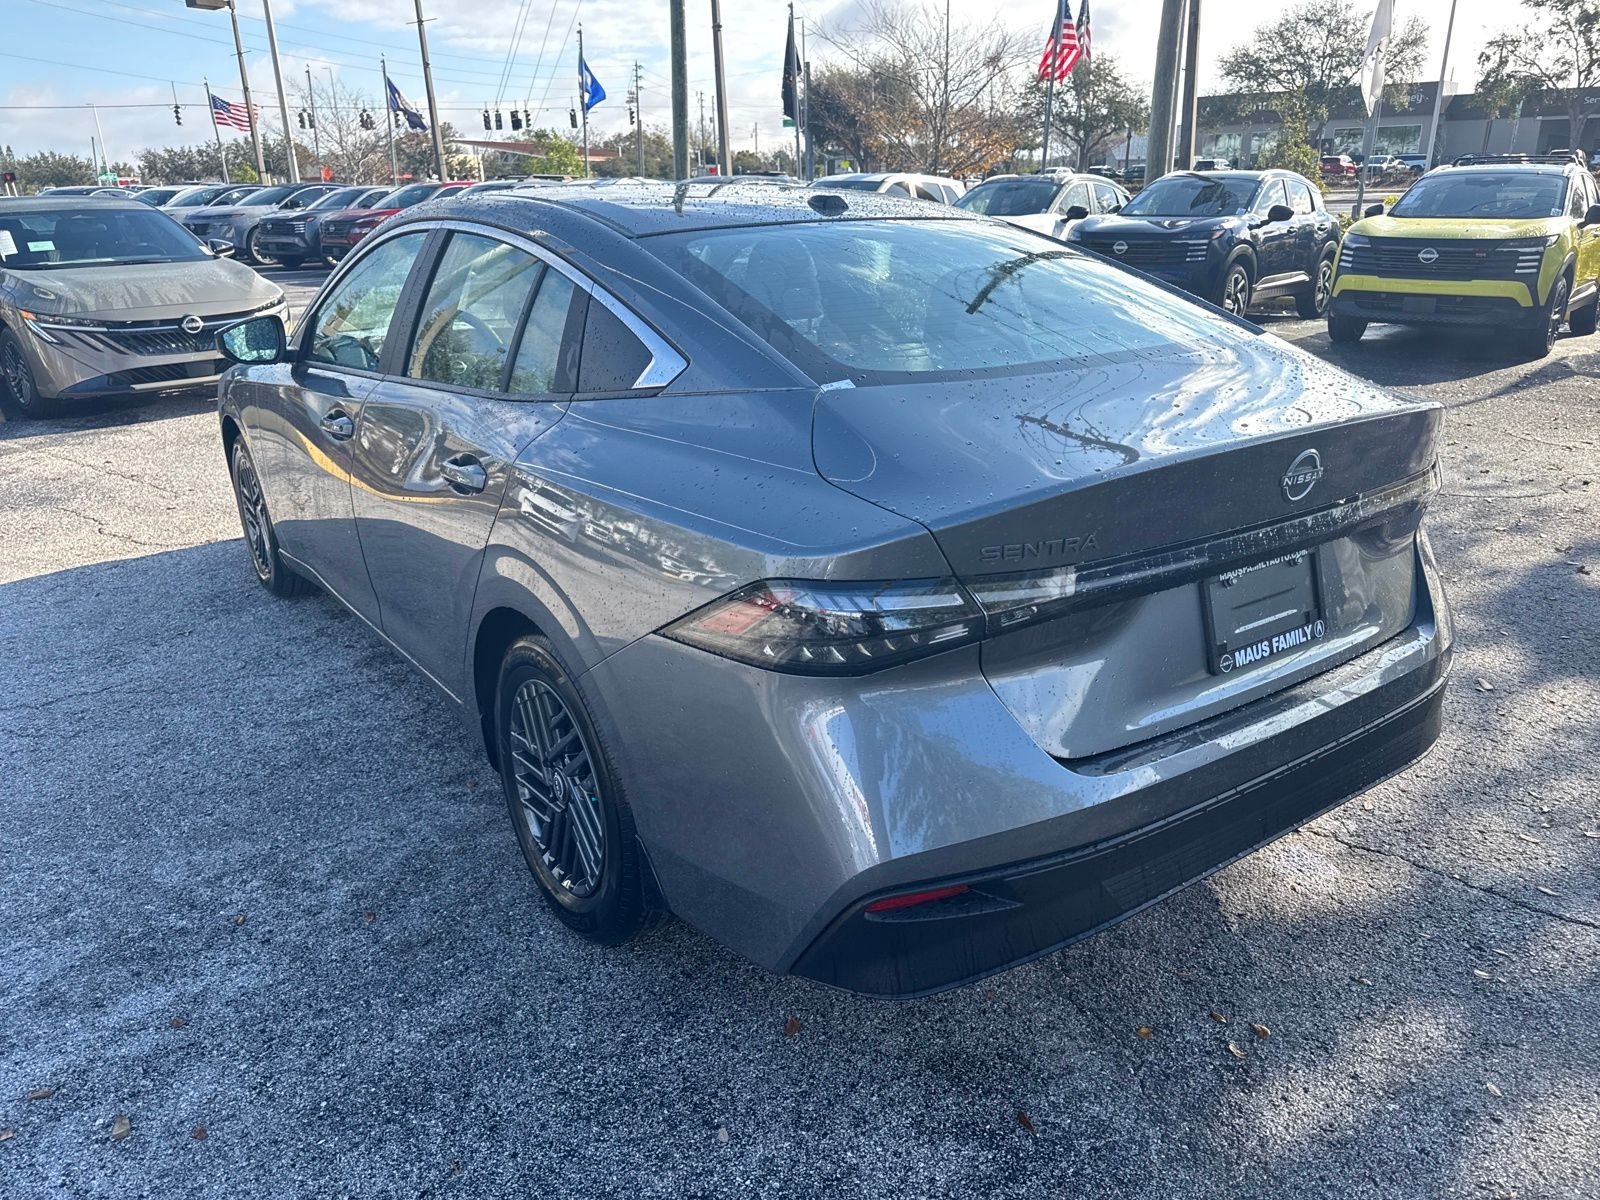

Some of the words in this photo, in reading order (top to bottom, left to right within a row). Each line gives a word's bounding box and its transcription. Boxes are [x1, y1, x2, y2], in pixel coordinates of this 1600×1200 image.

[1283, 470, 1323, 486] NISSAN
[979, 533, 1098, 561] SENTRA
[1234, 640, 1270, 667] MAUS
[1271, 624, 1313, 653] FAMILY
